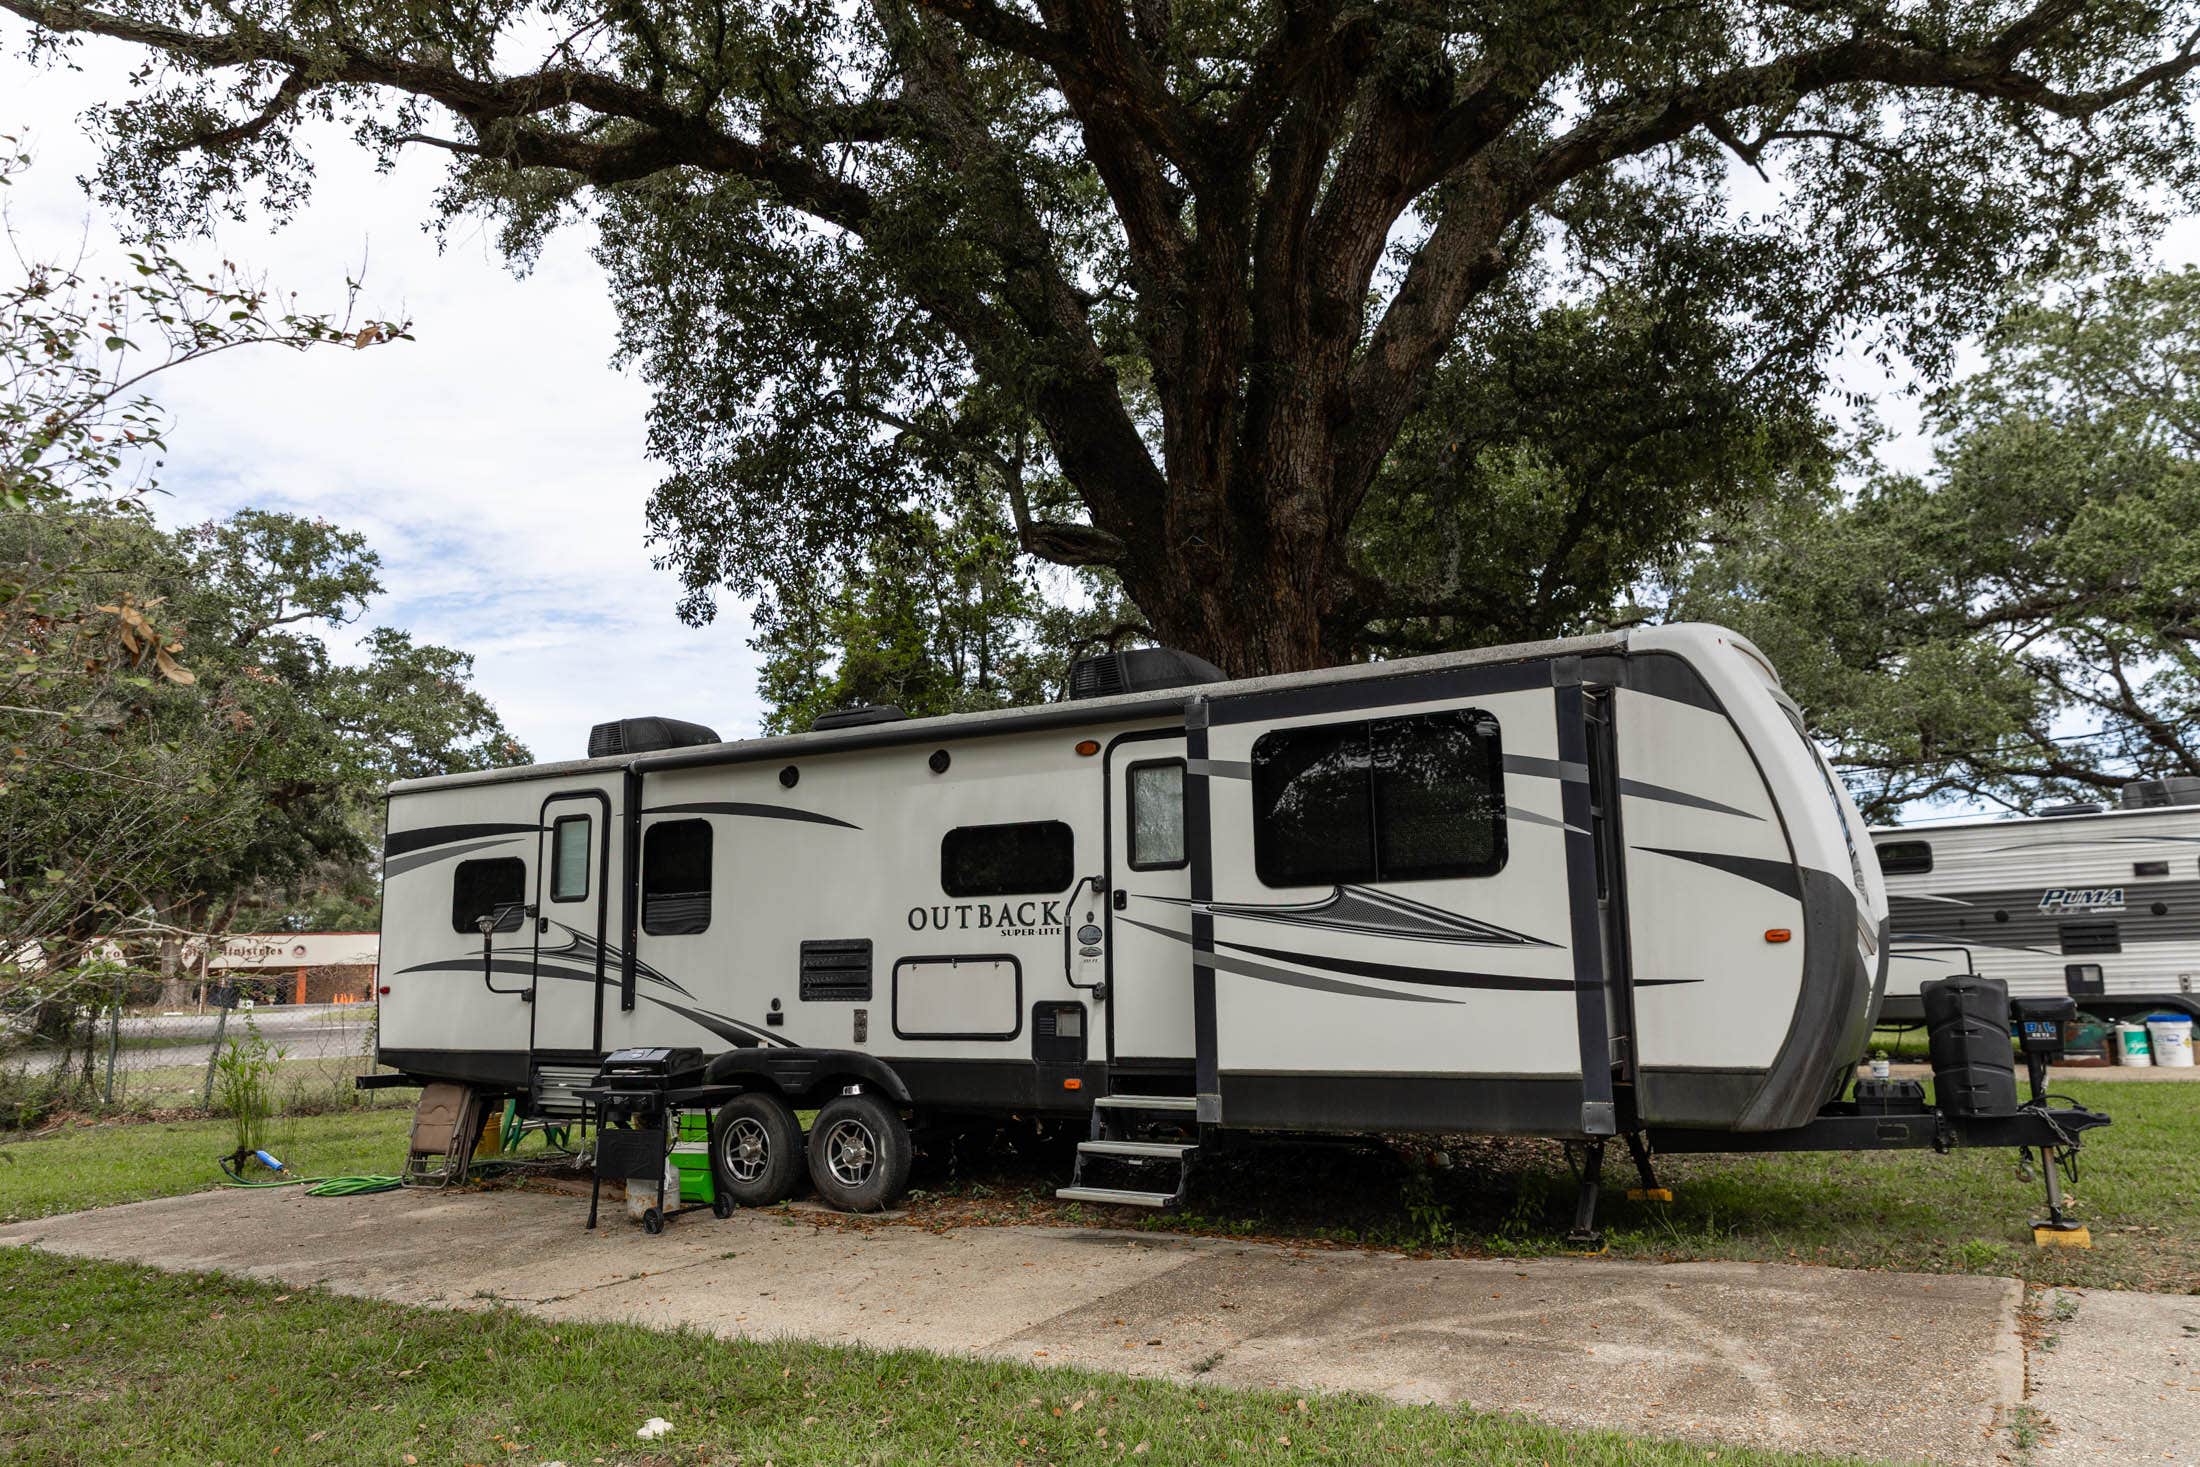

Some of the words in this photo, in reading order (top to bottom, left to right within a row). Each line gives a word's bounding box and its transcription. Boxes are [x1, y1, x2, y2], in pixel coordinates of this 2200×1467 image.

[2038, 888, 2125, 907] PUMA
[907, 900, 1063, 931] OUTBACK
[217, 945, 283, 957] inistries
